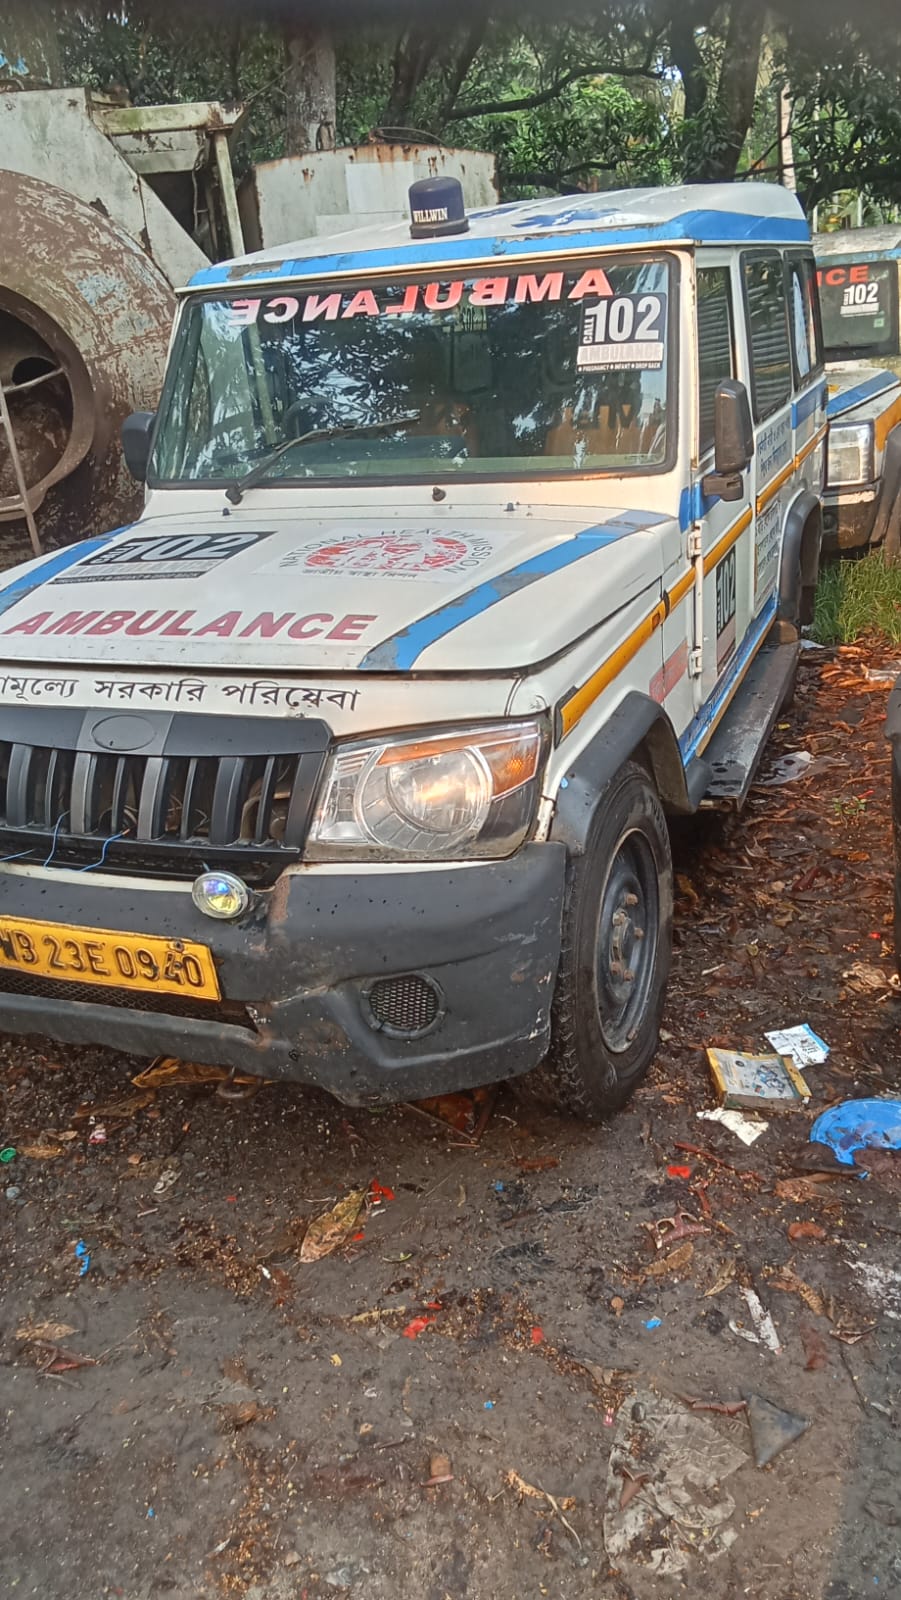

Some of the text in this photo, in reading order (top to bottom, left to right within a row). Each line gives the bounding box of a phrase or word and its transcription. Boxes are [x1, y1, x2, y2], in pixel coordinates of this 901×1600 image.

[815, 265, 869, 287] CE
[844, 283, 879, 305] 102
[583, 316, 595, 344] CALL
[585, 296, 661, 342] 102
[110, 533, 259, 562] 102
[279, 528, 494, 574] NATIONAL HEALTH MISSION
[717, 551, 736, 628] 102
[1, 610, 378, 641] AMBULANCE
[94, 678, 208, 701] সরকারি
[43, 935, 109, 976] 23E
[114, 945, 205, 988] 0940
